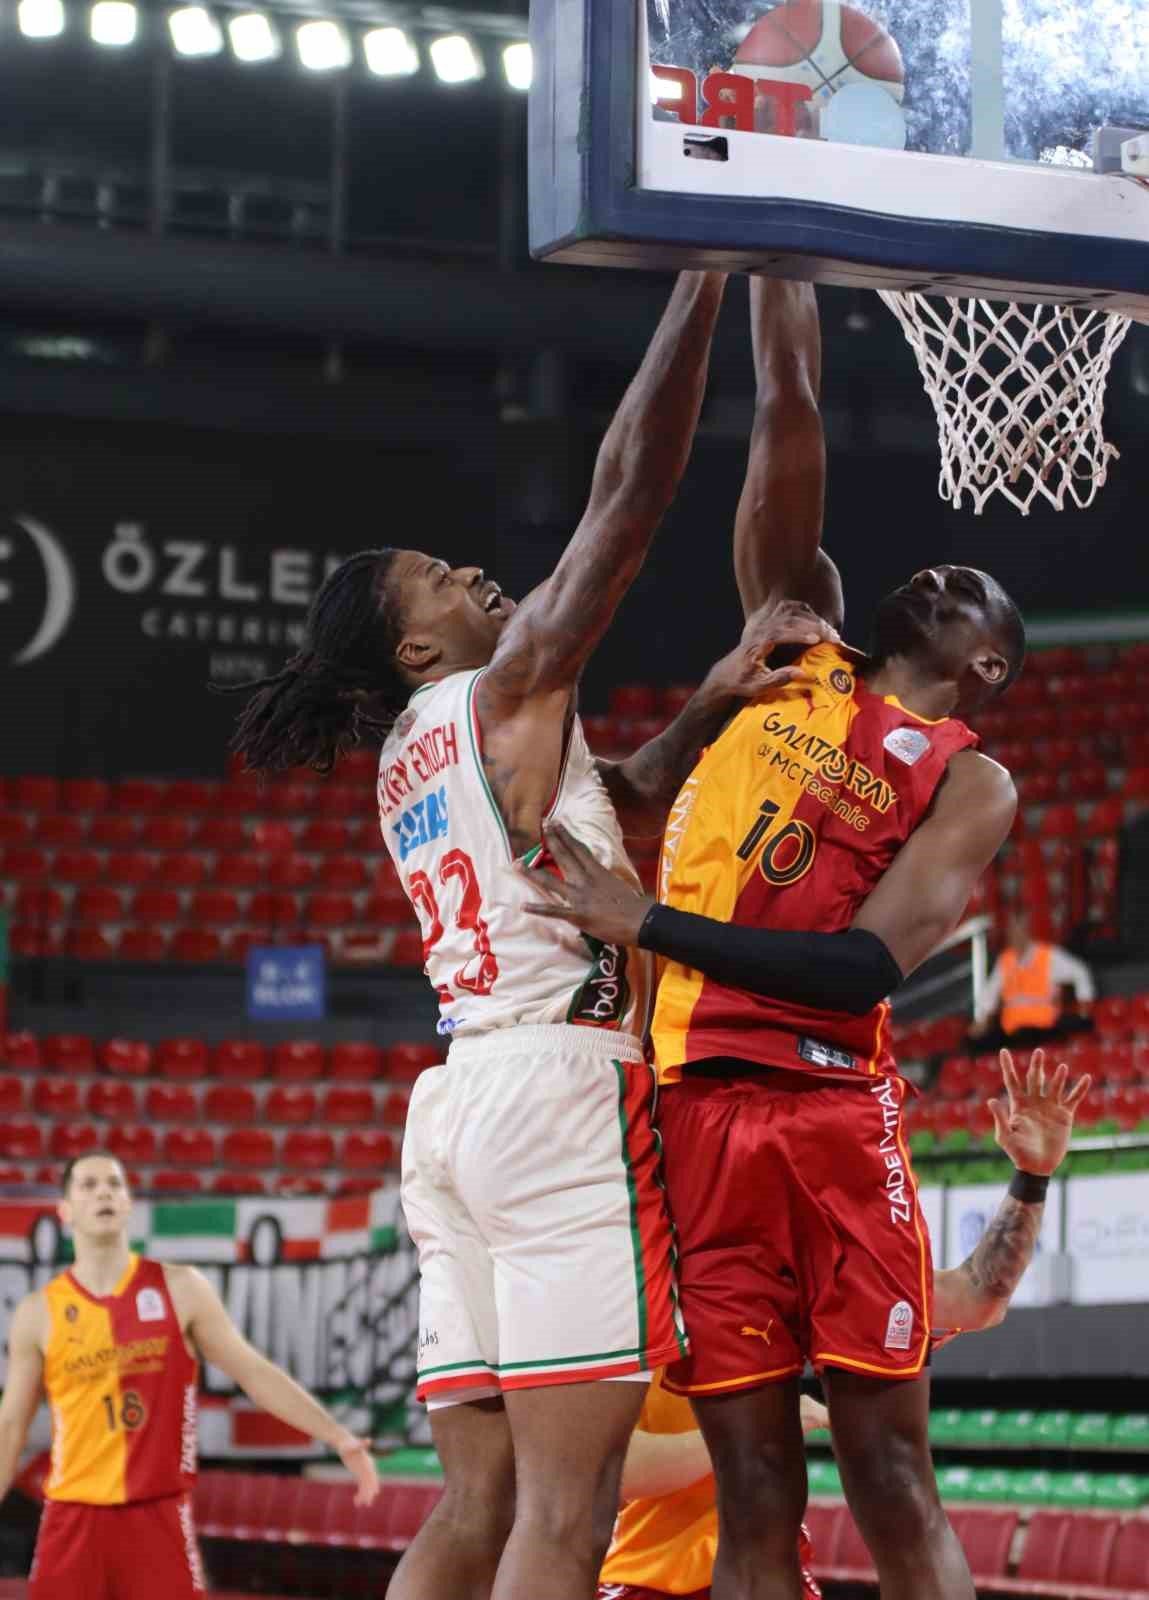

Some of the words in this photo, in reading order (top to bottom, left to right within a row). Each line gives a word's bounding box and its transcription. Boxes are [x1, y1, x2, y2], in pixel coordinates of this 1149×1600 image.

[102, 522, 342, 604] ÖZLE
[407, 722, 458, 782] ENOCH
[736, 798, 815, 885] 10
